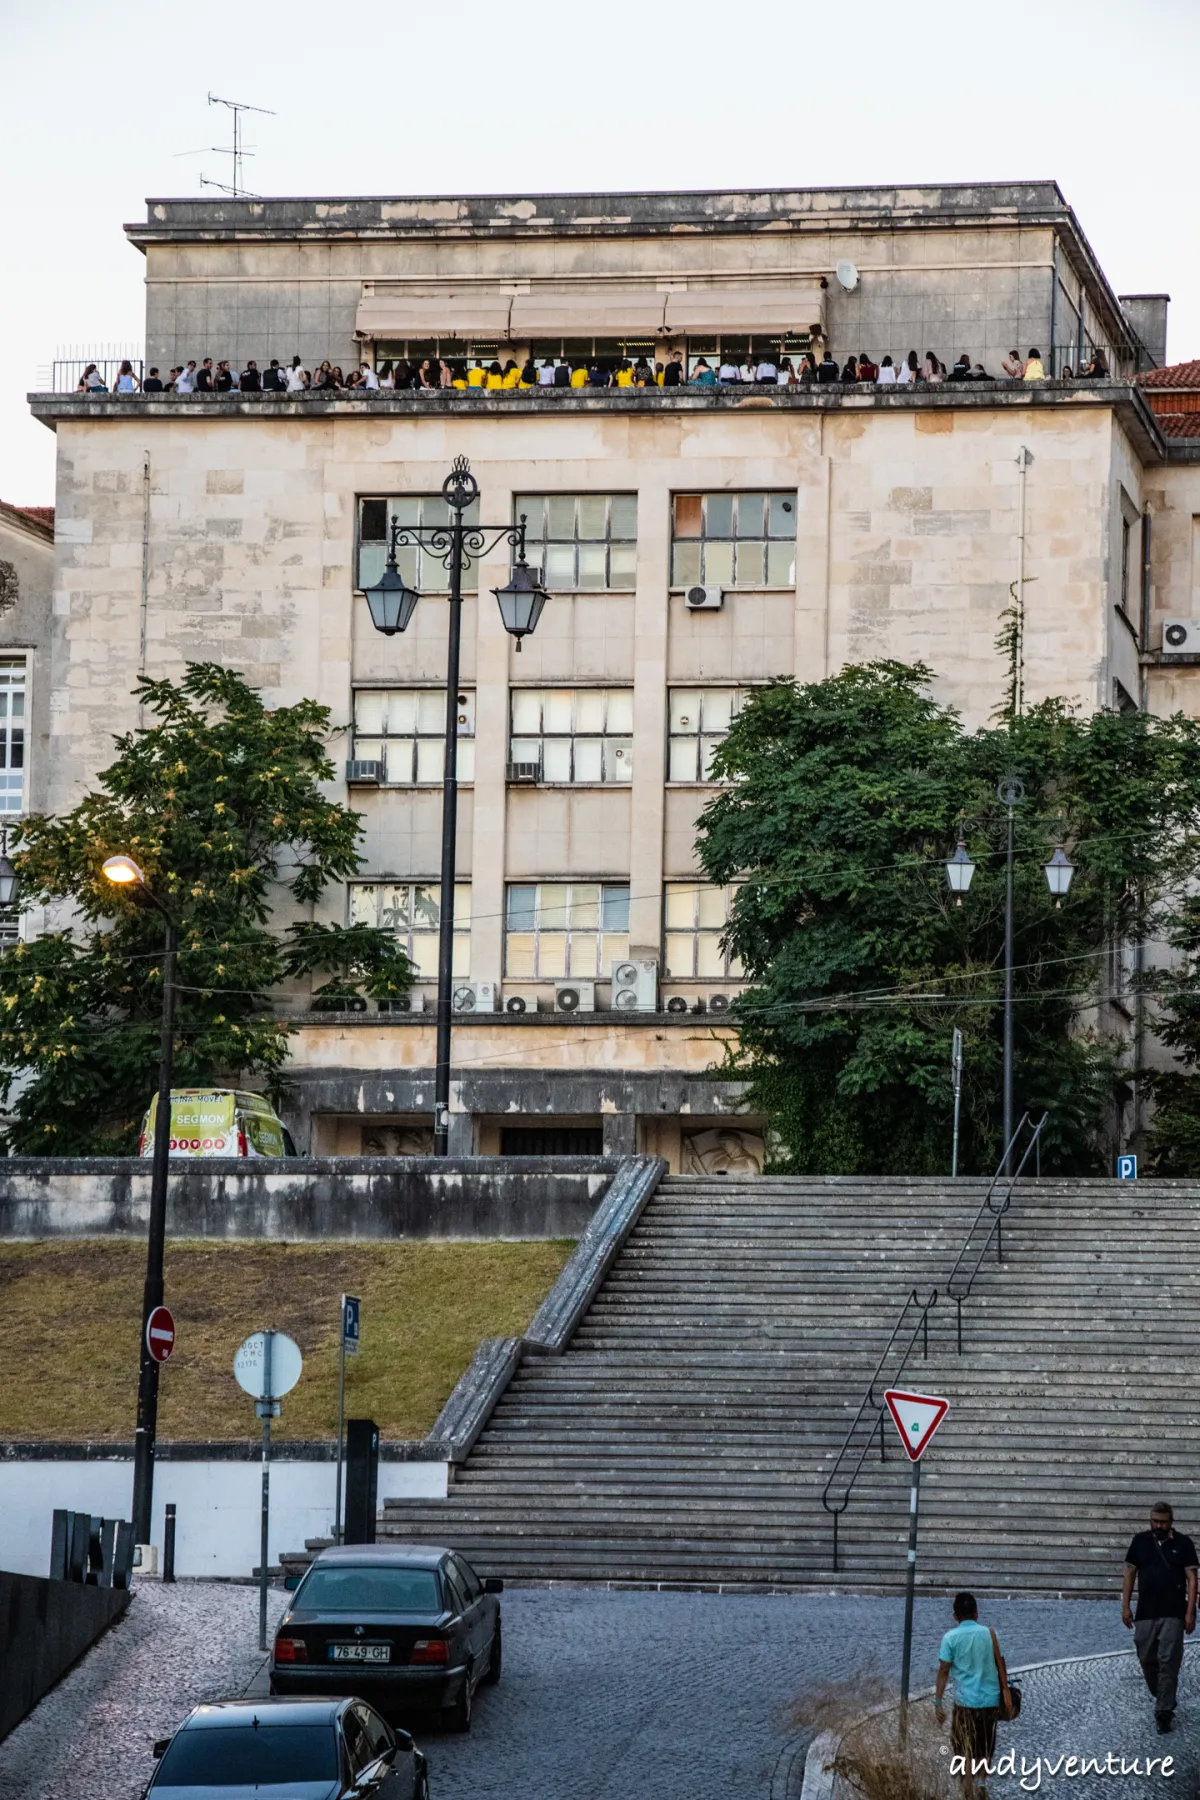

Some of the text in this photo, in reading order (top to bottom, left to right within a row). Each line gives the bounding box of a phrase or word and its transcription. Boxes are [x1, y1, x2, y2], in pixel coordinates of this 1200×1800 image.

[177, 1114, 225, 1124] SEGMON
[1121, 1159, 1132, 1179] P
[346, 1304, 354, 1334] P
